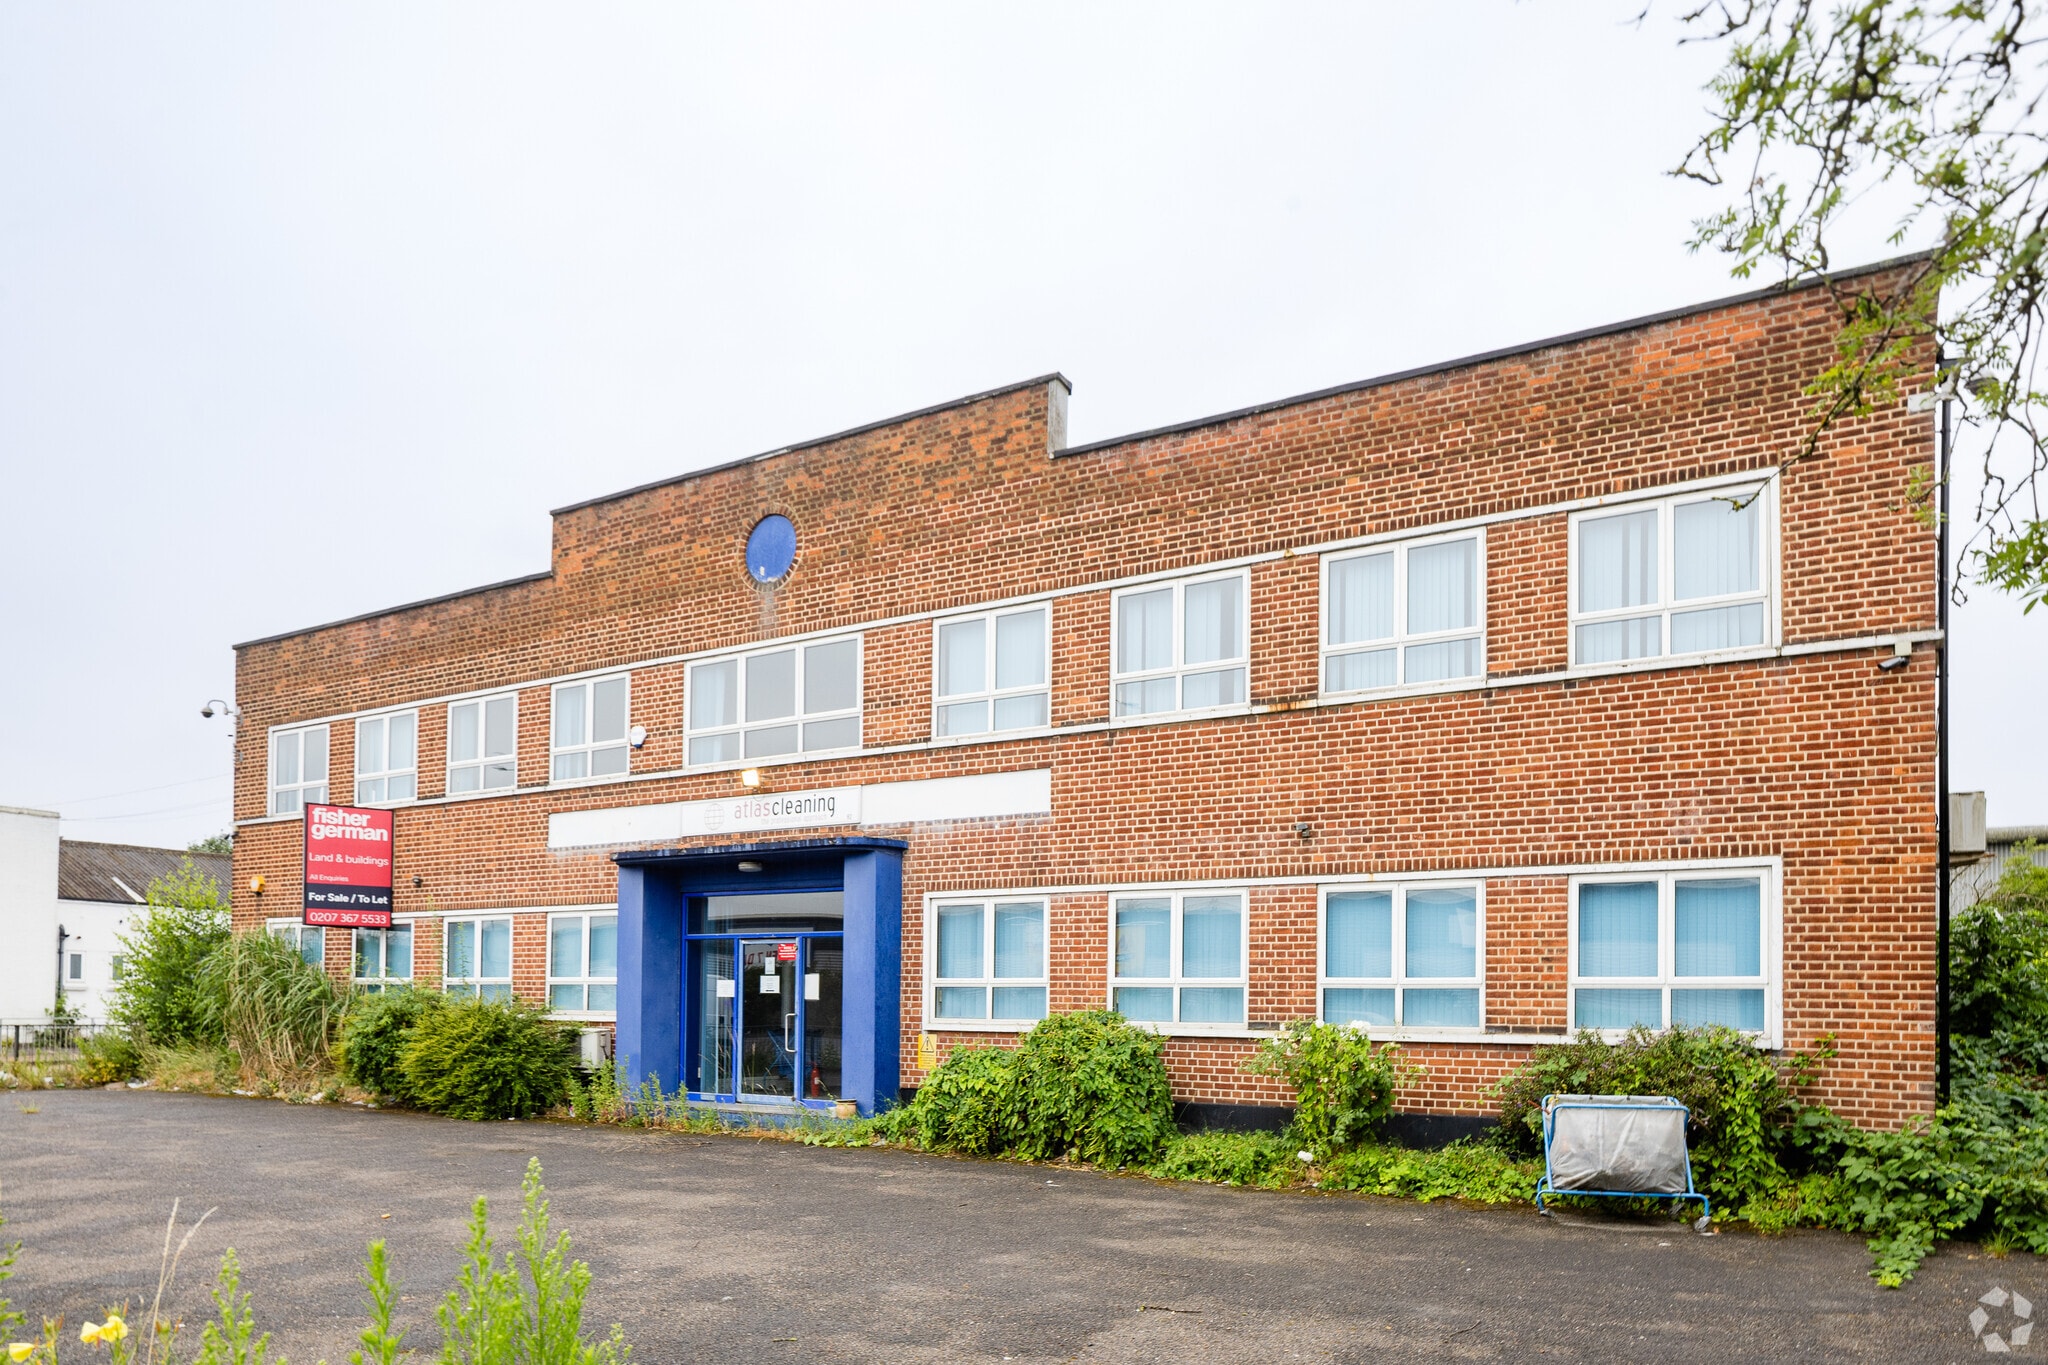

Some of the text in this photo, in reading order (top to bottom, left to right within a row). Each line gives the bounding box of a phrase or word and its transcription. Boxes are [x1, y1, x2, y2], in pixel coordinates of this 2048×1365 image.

[734, 793, 836, 819] atlascleaning
[312, 807, 371, 826] fisher
[311, 824, 388, 841] german
[309, 852, 389, 867] Land & buildings
[319, 874, 349, 882] Enquiries
[308, 892, 388, 904] For Sale / To Let
[310, 912, 387, 924] 0207 367 5533
